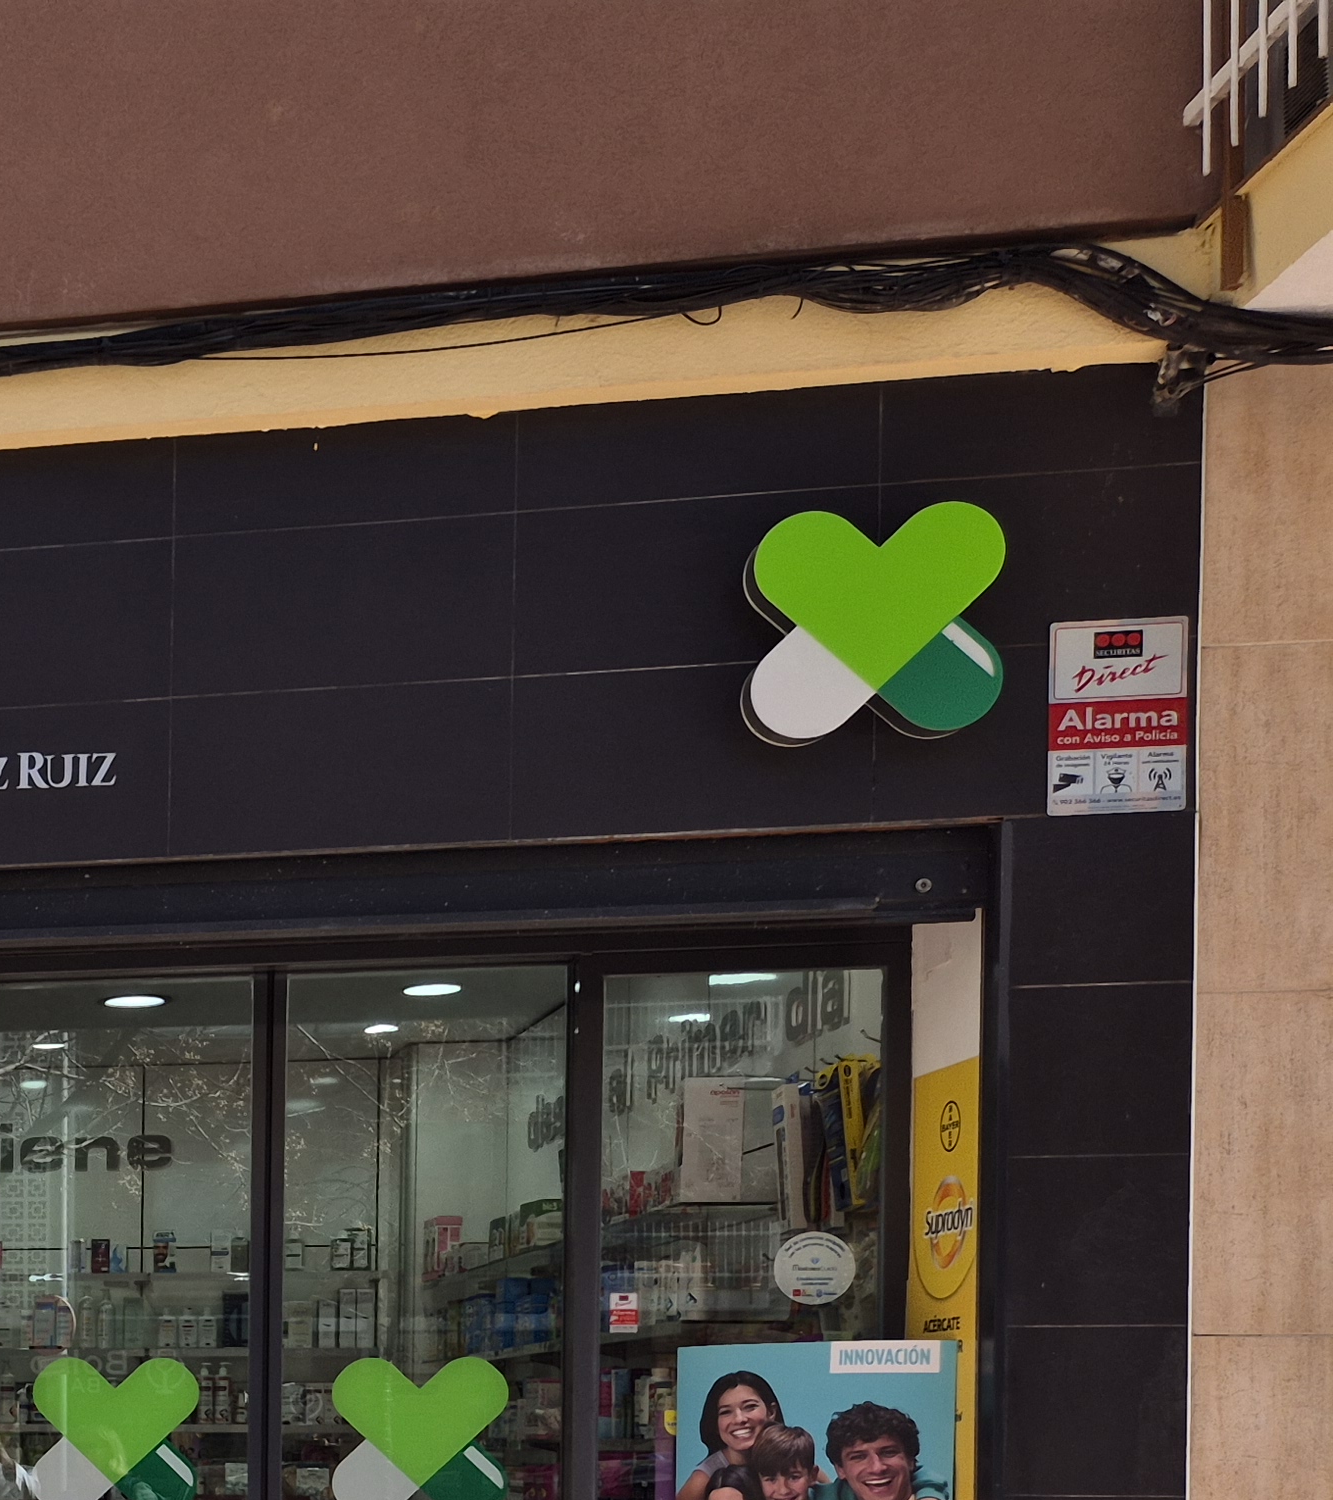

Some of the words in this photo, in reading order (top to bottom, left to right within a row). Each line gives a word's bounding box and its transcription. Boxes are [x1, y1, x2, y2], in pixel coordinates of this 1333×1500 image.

[1096, 647, 1141, 656] SECURITAS
[1072, 654, 1169, 693] Direct
[1057, 707, 1178, 731] Alarma
[1057, 736, 1080, 745] con
[1083, 733, 1120, 744] Aviso
[1123, 734, 1132, 742] a
[1135, 729, 1178, 741] Policía
[16, 751, 117, 789] RUIZ
[922, 1315, 961, 1333] ACÉRCATE
[838, 1344, 931, 1366] INNOVACIÓN
